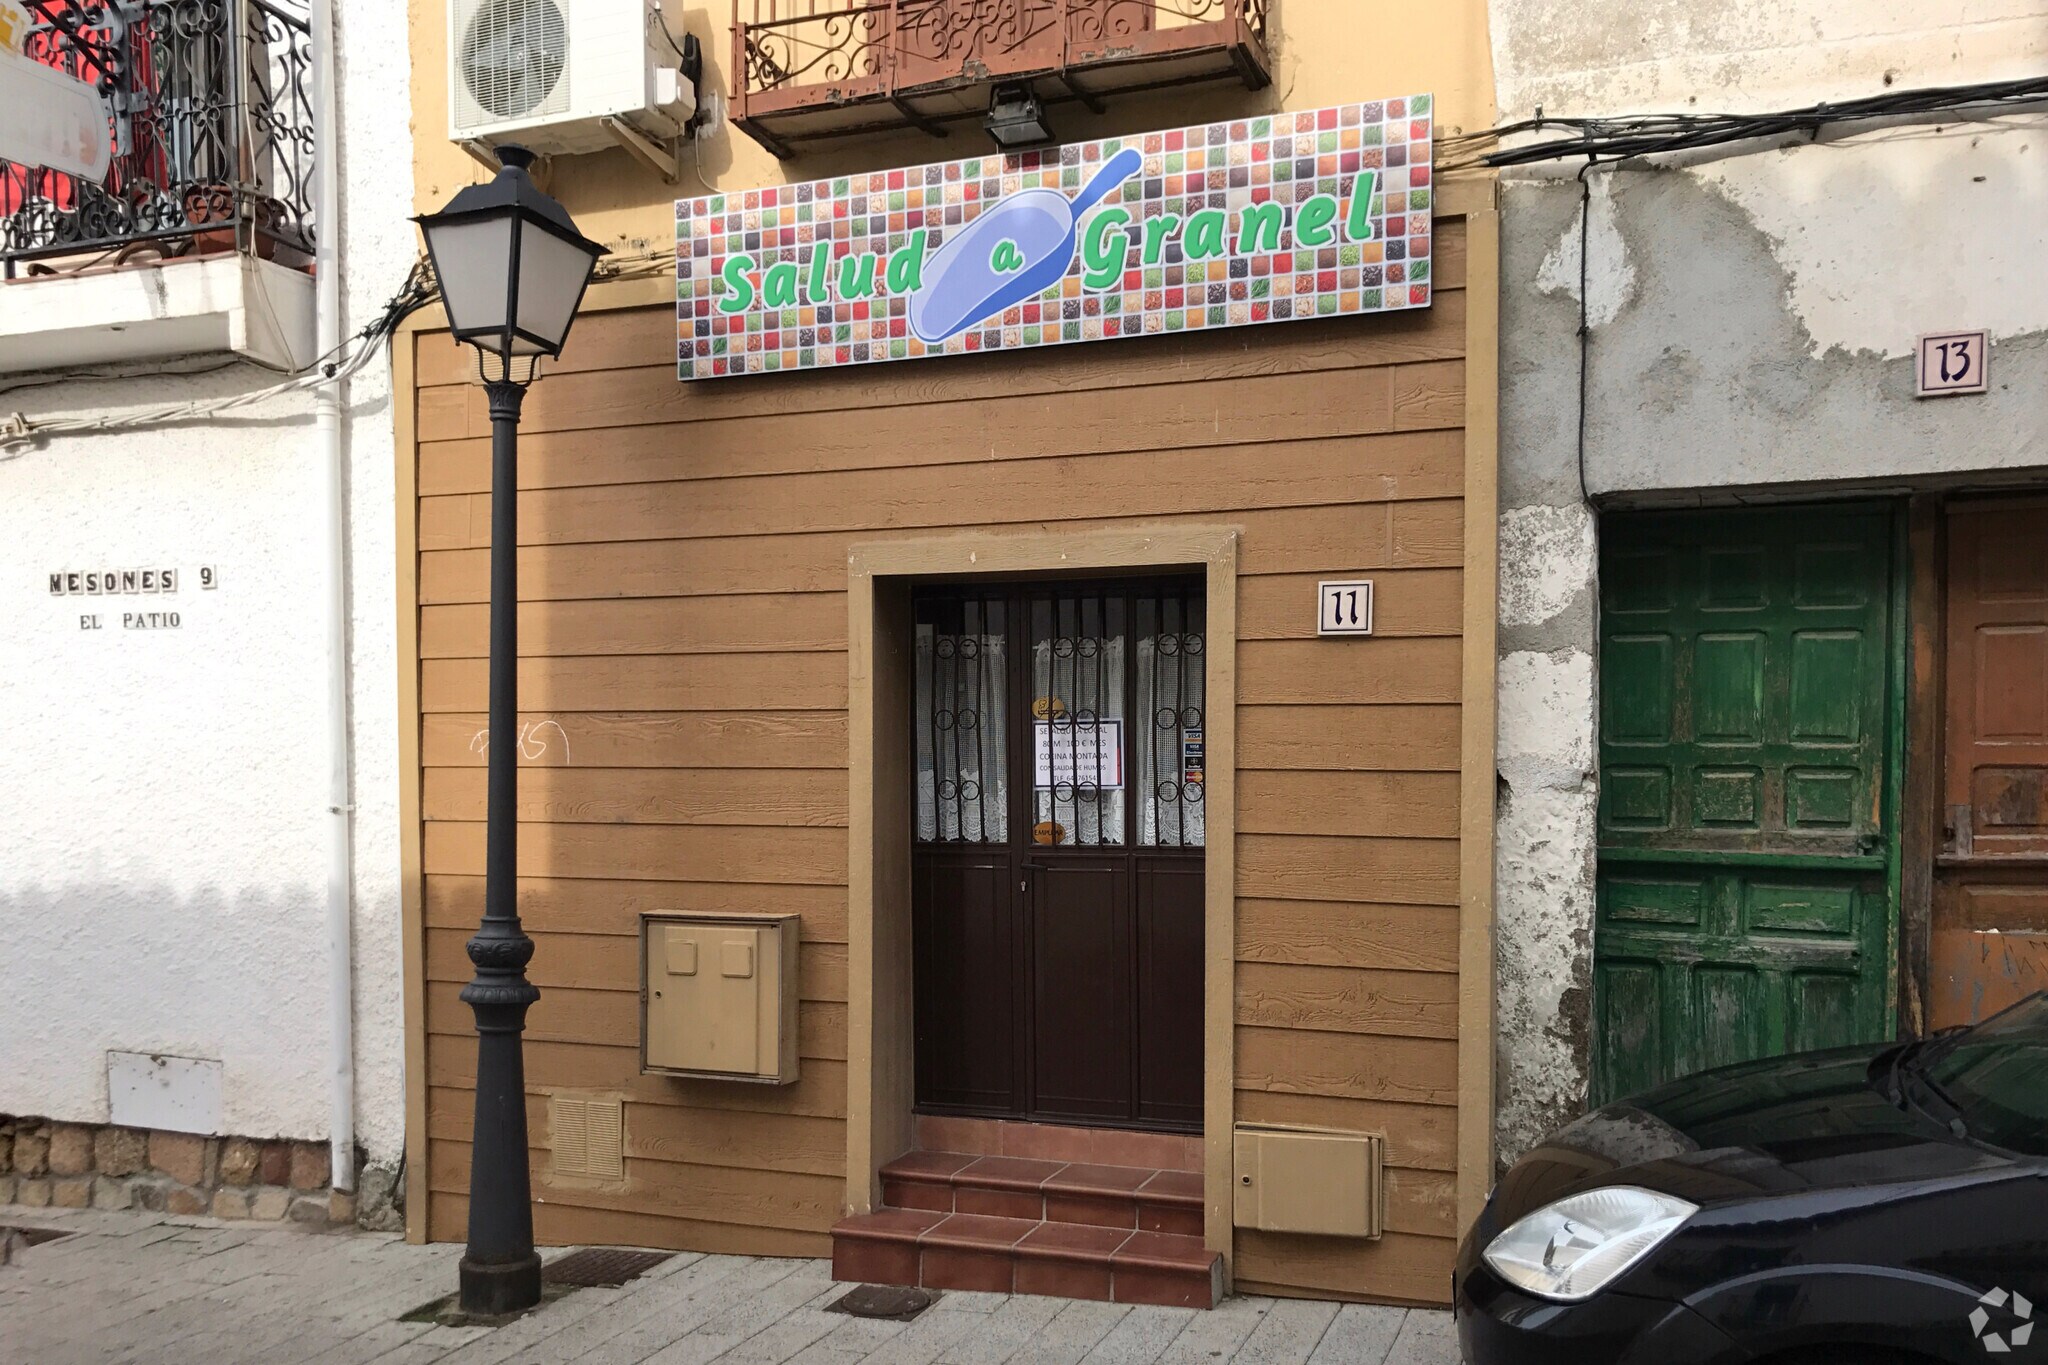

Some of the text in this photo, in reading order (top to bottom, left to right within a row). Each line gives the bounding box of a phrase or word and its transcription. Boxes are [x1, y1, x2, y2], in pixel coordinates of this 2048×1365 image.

[719, 170, 1376, 313] Salud a Granel
[1935, 340, 1971, 383] 13
[50, 567, 213, 593] MESONES 9
[80, 612, 181, 630] EL PATIO
[1331, 590, 1359, 626] 11
[1039, 727, 1048, 735] SE
[1039, 753, 1067, 761] COINA
